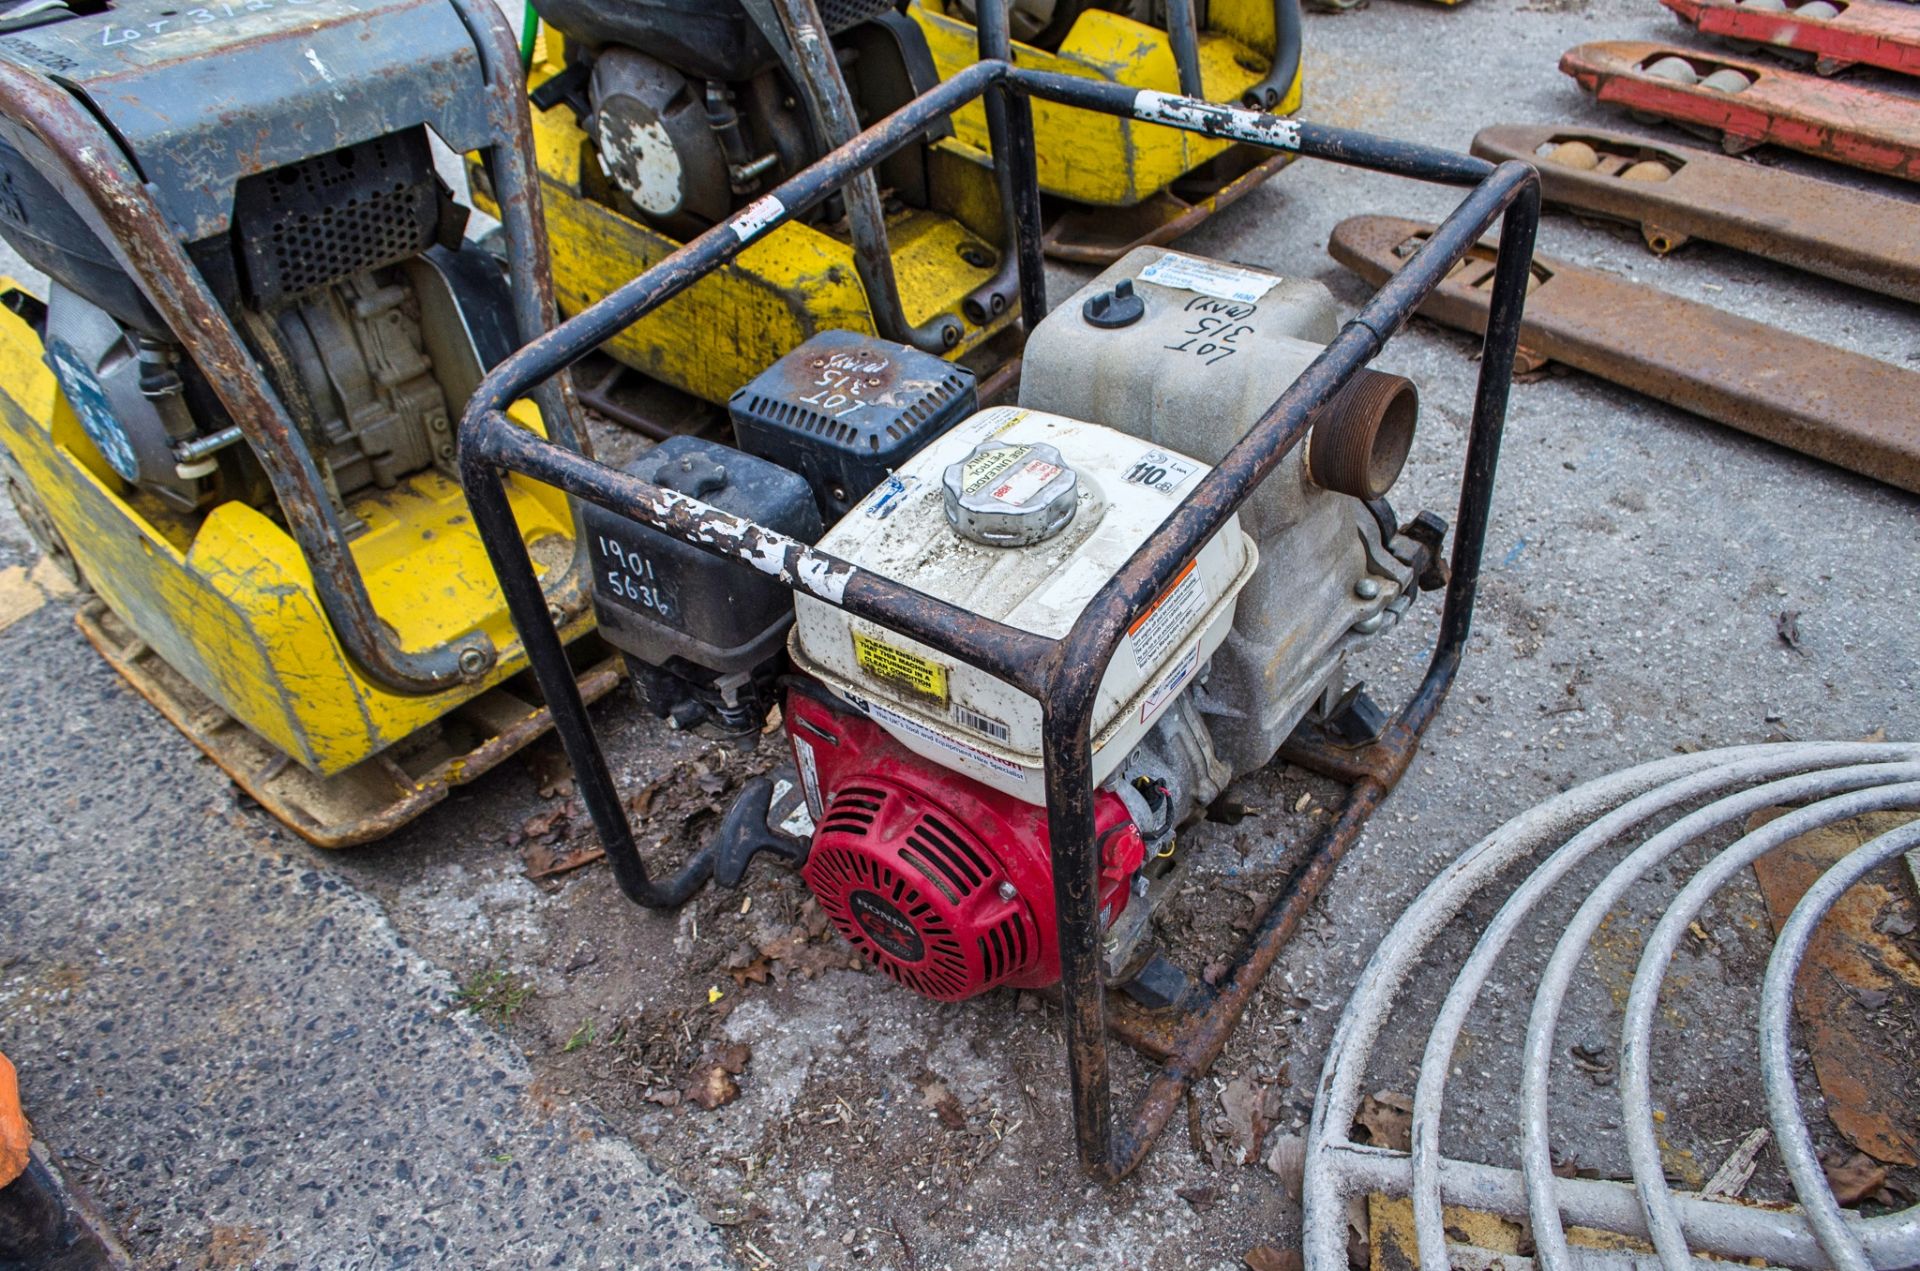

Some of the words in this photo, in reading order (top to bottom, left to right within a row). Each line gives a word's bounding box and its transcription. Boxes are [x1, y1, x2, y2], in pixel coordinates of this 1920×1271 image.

[102, 20, 170, 46] LOT
[1185, 317, 1255, 343] 315
[1164, 339, 1236, 365] LOT
[800, 390, 866, 417] LOT
[967, 451, 990, 469] ONLY
[969, 452, 1005, 476] PETROL
[1010, 446, 1031, 459] USE
[965, 458, 1012, 493] UNLEADED
[1128, 462, 1166, 485] 110
[599, 536, 653, 579] 1901
[608, 571, 668, 615] 5636
[860, 641, 877, 652] THAT
[879, 649, 896, 660] THIS
[898, 657, 933, 676] MACHINE
[864, 638, 893, 653] PLEASE
[895, 649, 925, 666] ENSURE
[864, 655, 888, 670] CLEAN
[889, 666, 931, 688] CONDITION
[873, 653, 912, 674] RETURNED
[914, 670, 922, 678] IN
[856, 896, 916, 935] HONDA
